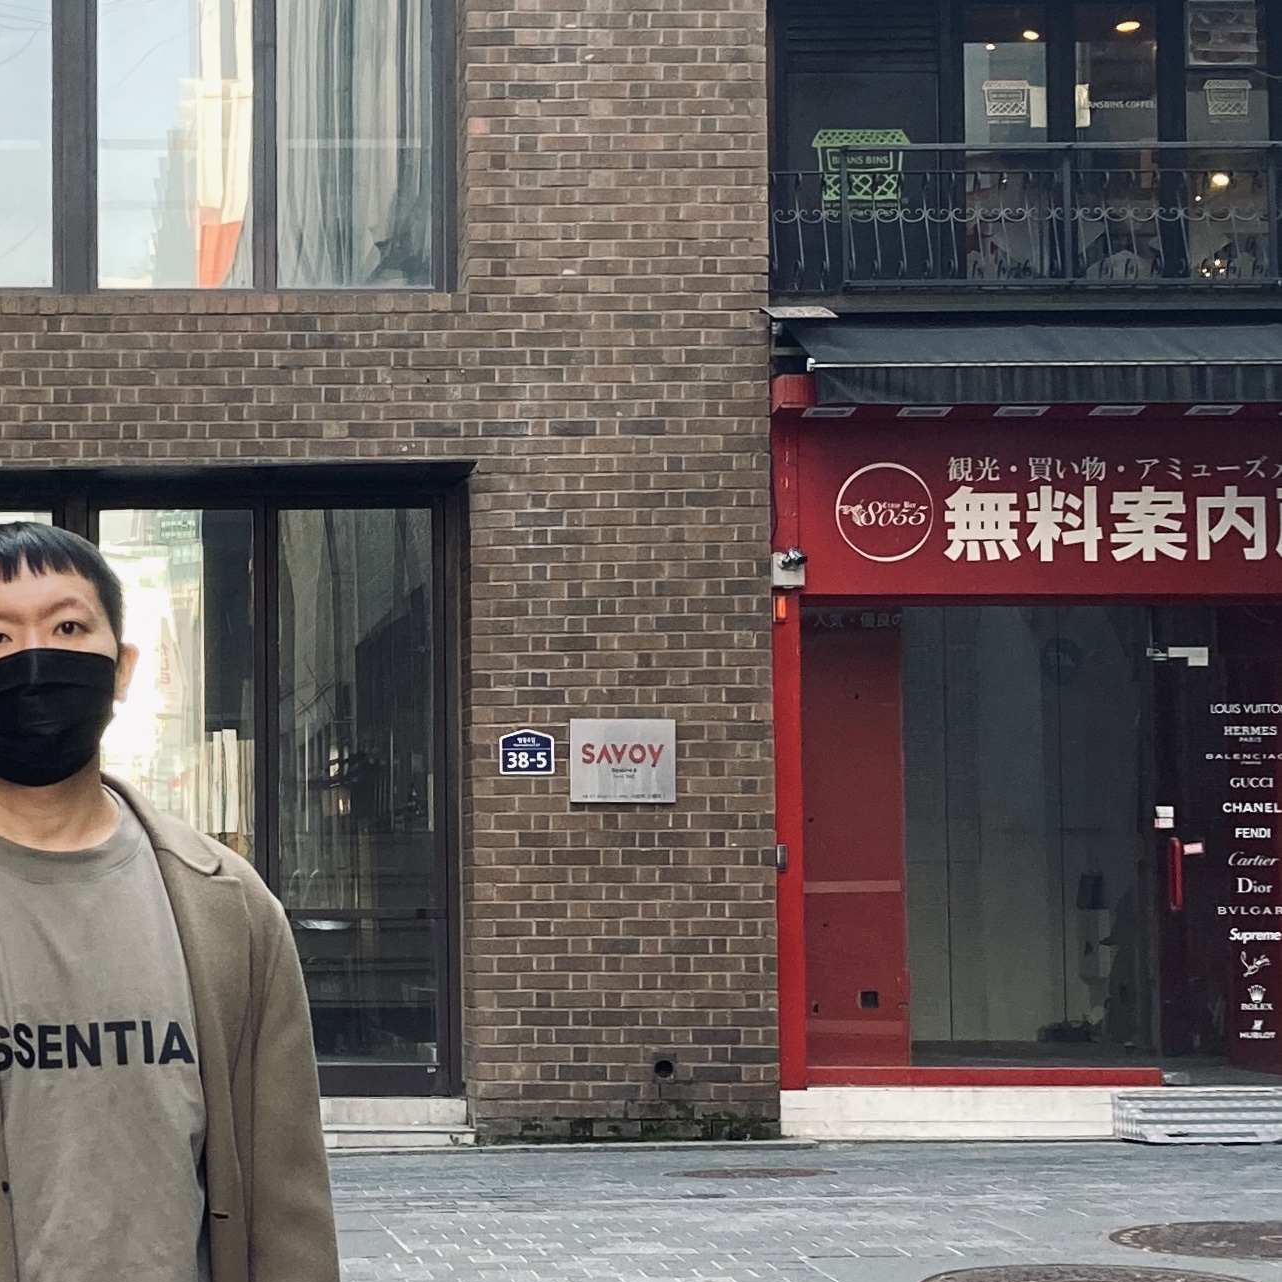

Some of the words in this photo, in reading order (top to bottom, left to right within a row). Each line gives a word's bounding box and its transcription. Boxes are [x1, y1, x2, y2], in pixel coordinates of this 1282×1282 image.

[832, 155, 863, 165] BNS
[865, 155, 889, 164] BINS
[860, 500, 929, 527] 8055
[1209, 703, 1241, 714] LOUIS
[1223, 726, 1278, 736] HERMES
[507, 751, 548, 769] 38-5
[581, 742, 665, 768] SAVOY
[1229, 777, 1274, 788] GUCCI
[1222, 802, 1282, 813] CHANEL
[1234, 827, 1272, 839] FENDI
[1227, 851, 1280, 867] Cartier
[1236, 877, 1273, 894] Dior
[1217, 906, 1282, 915] BVLGAR
[1229, 927, 1282, 944] Supreme
